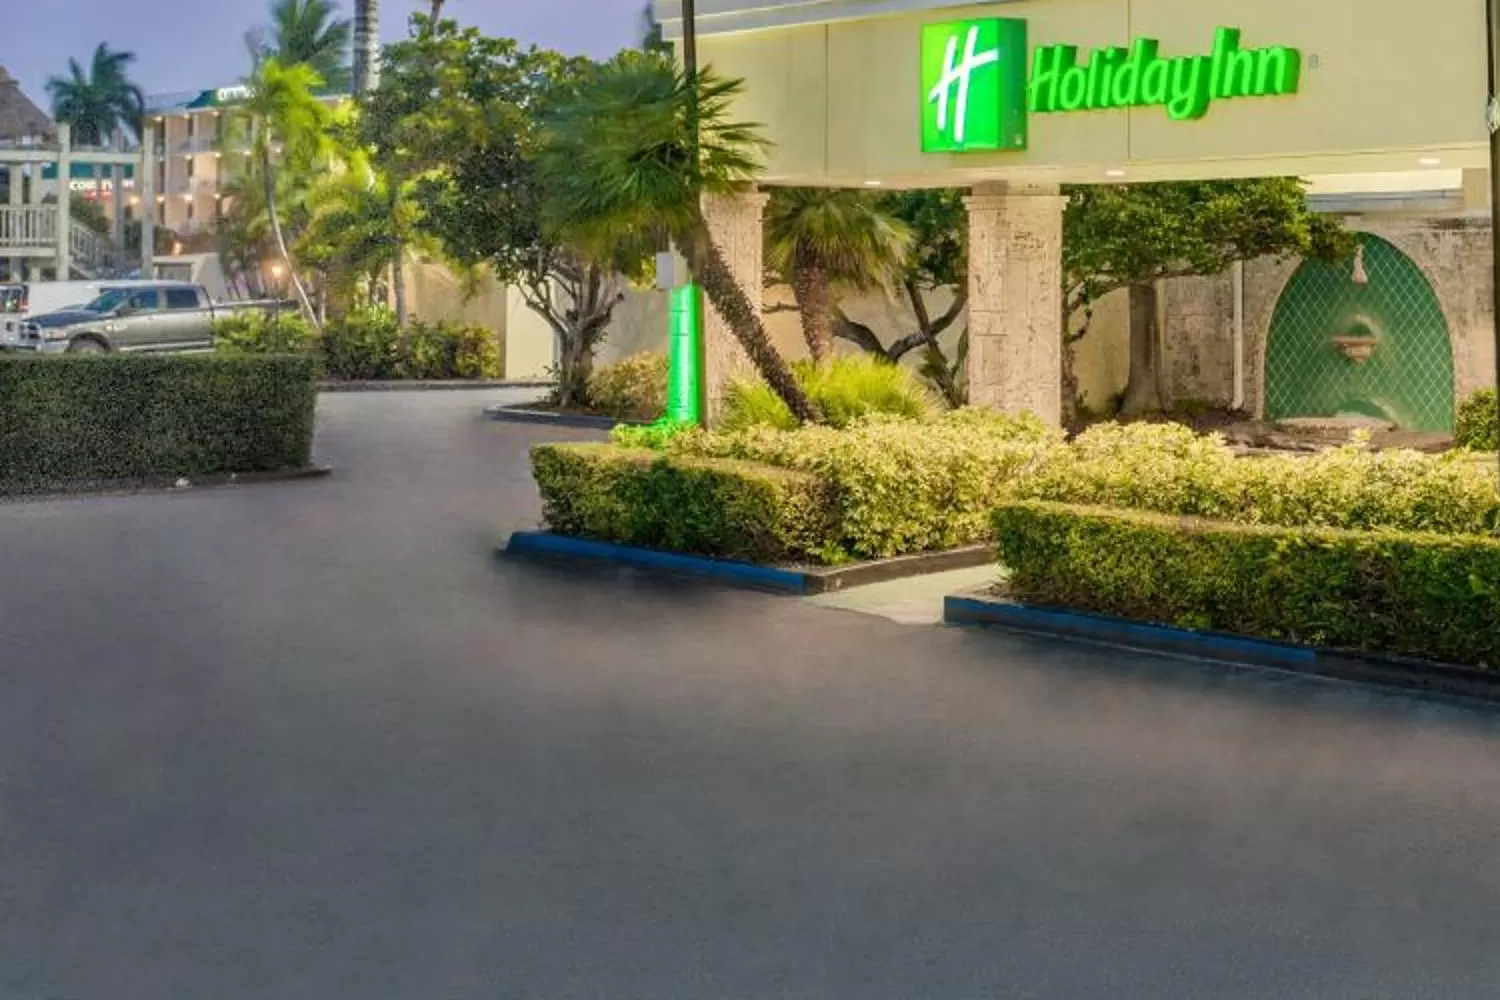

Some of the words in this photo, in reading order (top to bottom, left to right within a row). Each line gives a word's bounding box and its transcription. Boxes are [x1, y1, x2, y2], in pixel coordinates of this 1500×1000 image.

[928, 25, 999, 143] H
[1027, 37, 1207, 120] Holiday
[1209, 26, 1293, 98] Inn
